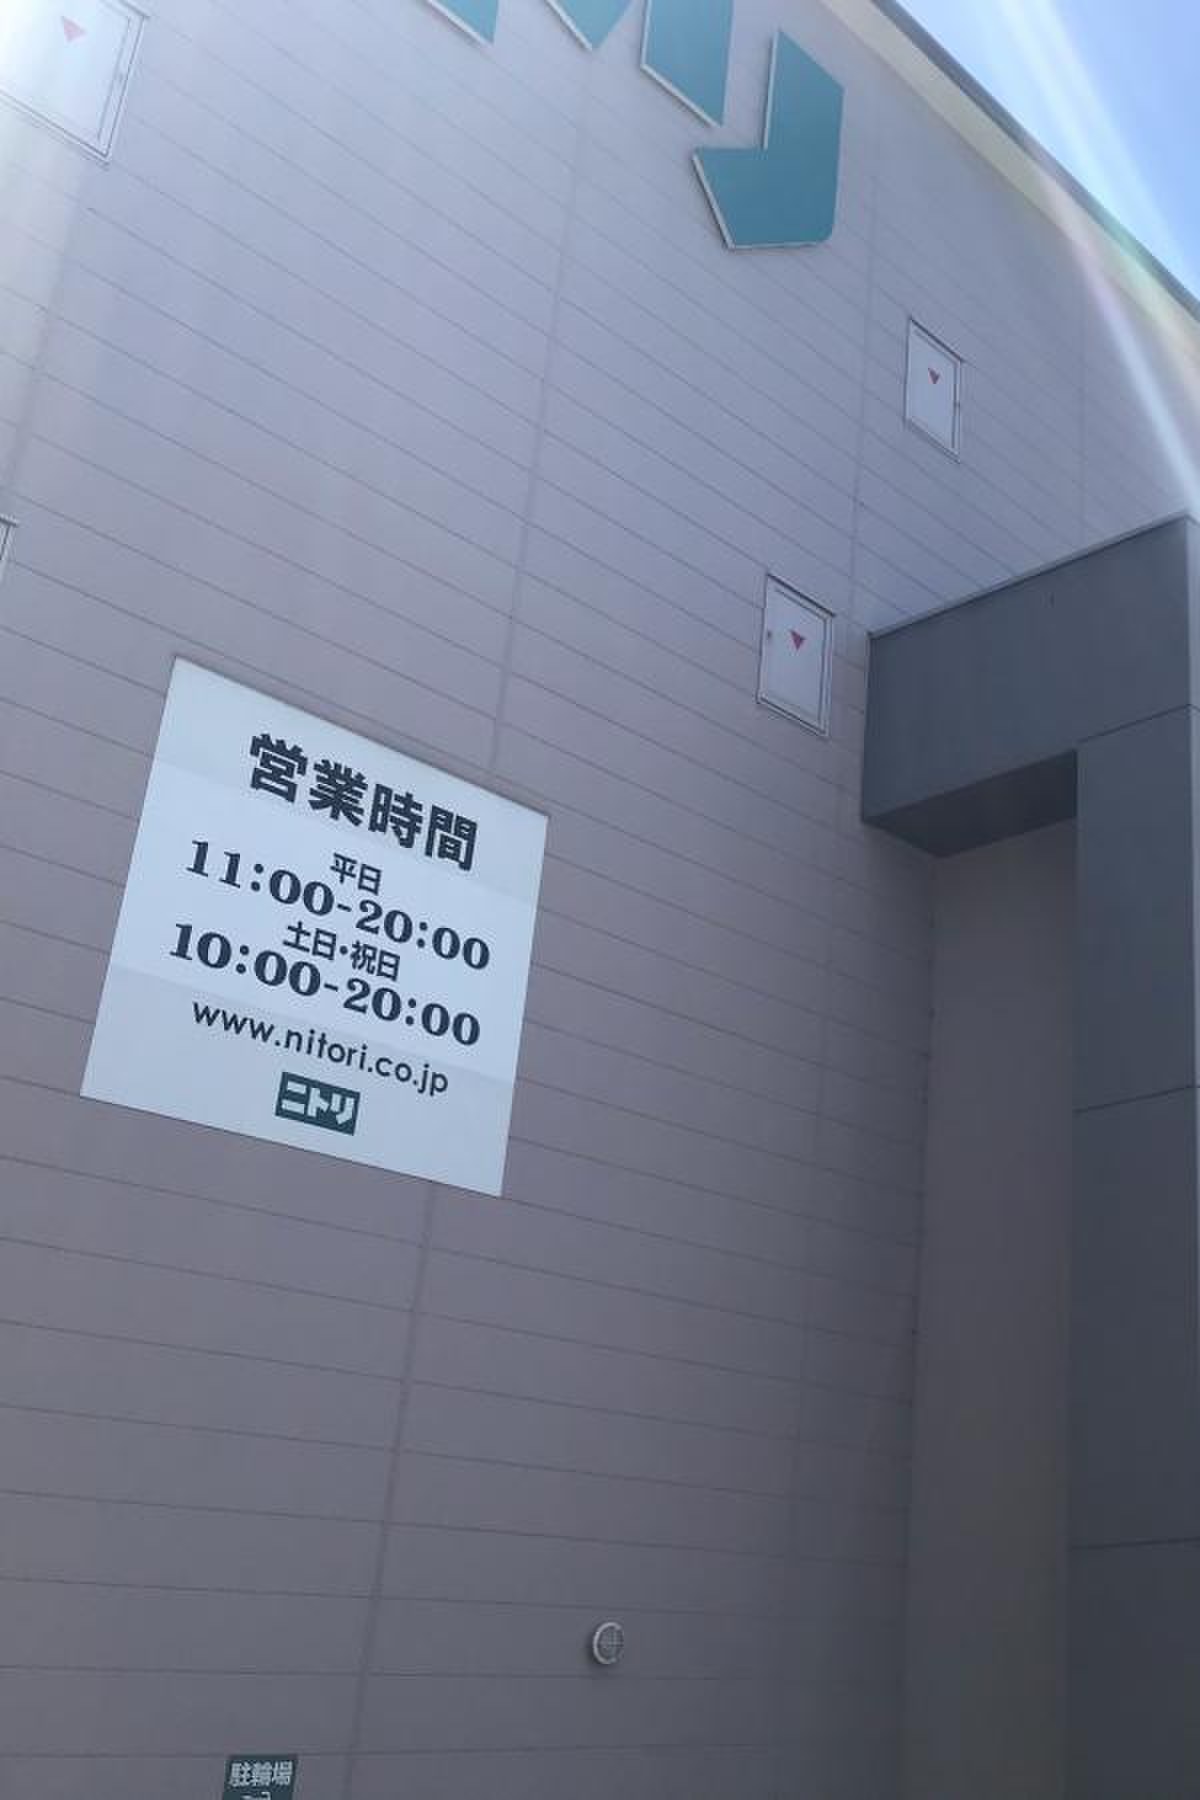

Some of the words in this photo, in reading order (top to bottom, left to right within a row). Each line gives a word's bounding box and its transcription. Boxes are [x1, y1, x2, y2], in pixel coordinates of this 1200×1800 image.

[249, 733, 478, 871] 営業時間
[186, 840, 490, 970] 11:00-20:00
[330, 852, 382, 895] 平日
[170, 923, 481, 1046] 10:00-20:00
[193, 1002, 449, 1096] www.nitori.co.jp
[278, 1075, 357, 1130] ニトリ
[229, 1760, 293, 1788] 駐輪場
